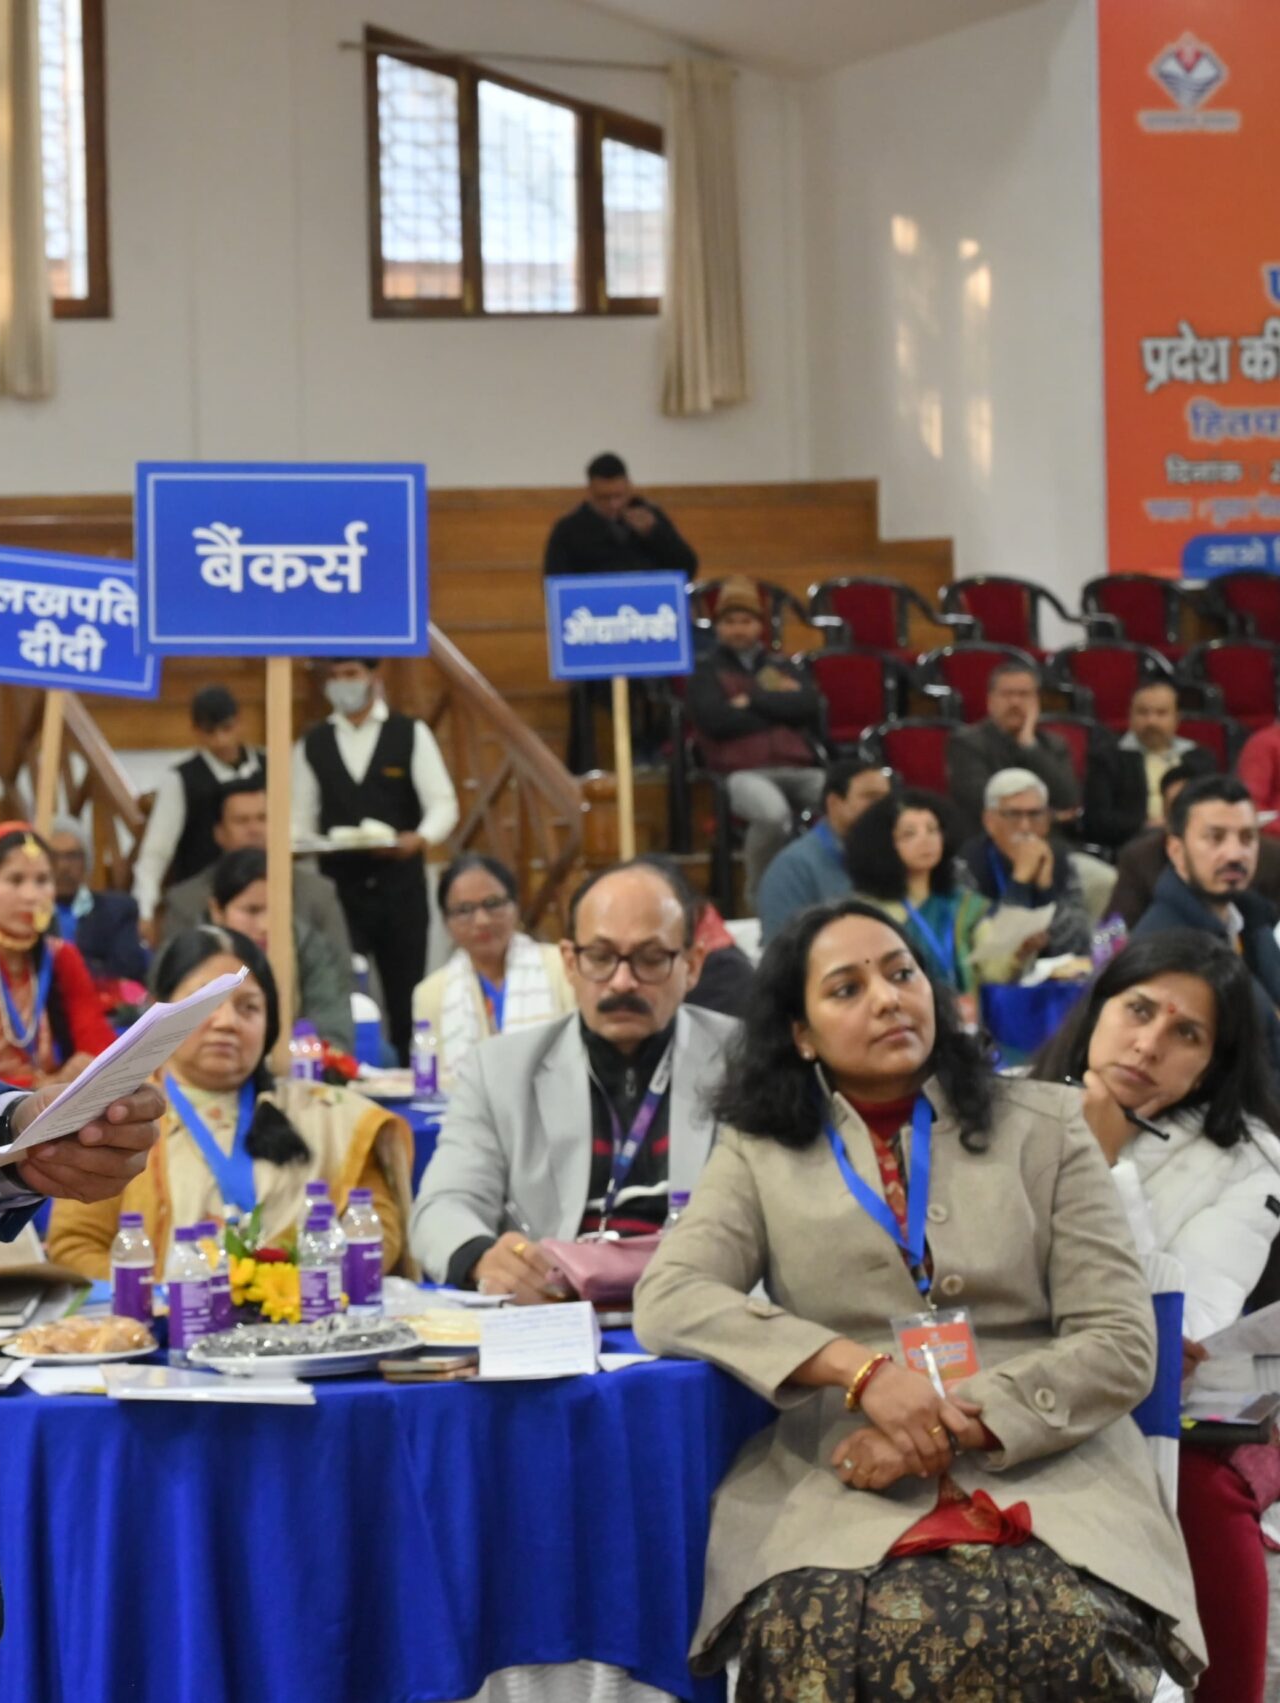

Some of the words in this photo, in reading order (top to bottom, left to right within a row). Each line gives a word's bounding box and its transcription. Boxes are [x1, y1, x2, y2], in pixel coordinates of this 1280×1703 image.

[1141, 319, 1231, 393] प्रदेश
[192, 520, 369, 593] बैंकर्स
[18, 619, 108, 672] दीदी
